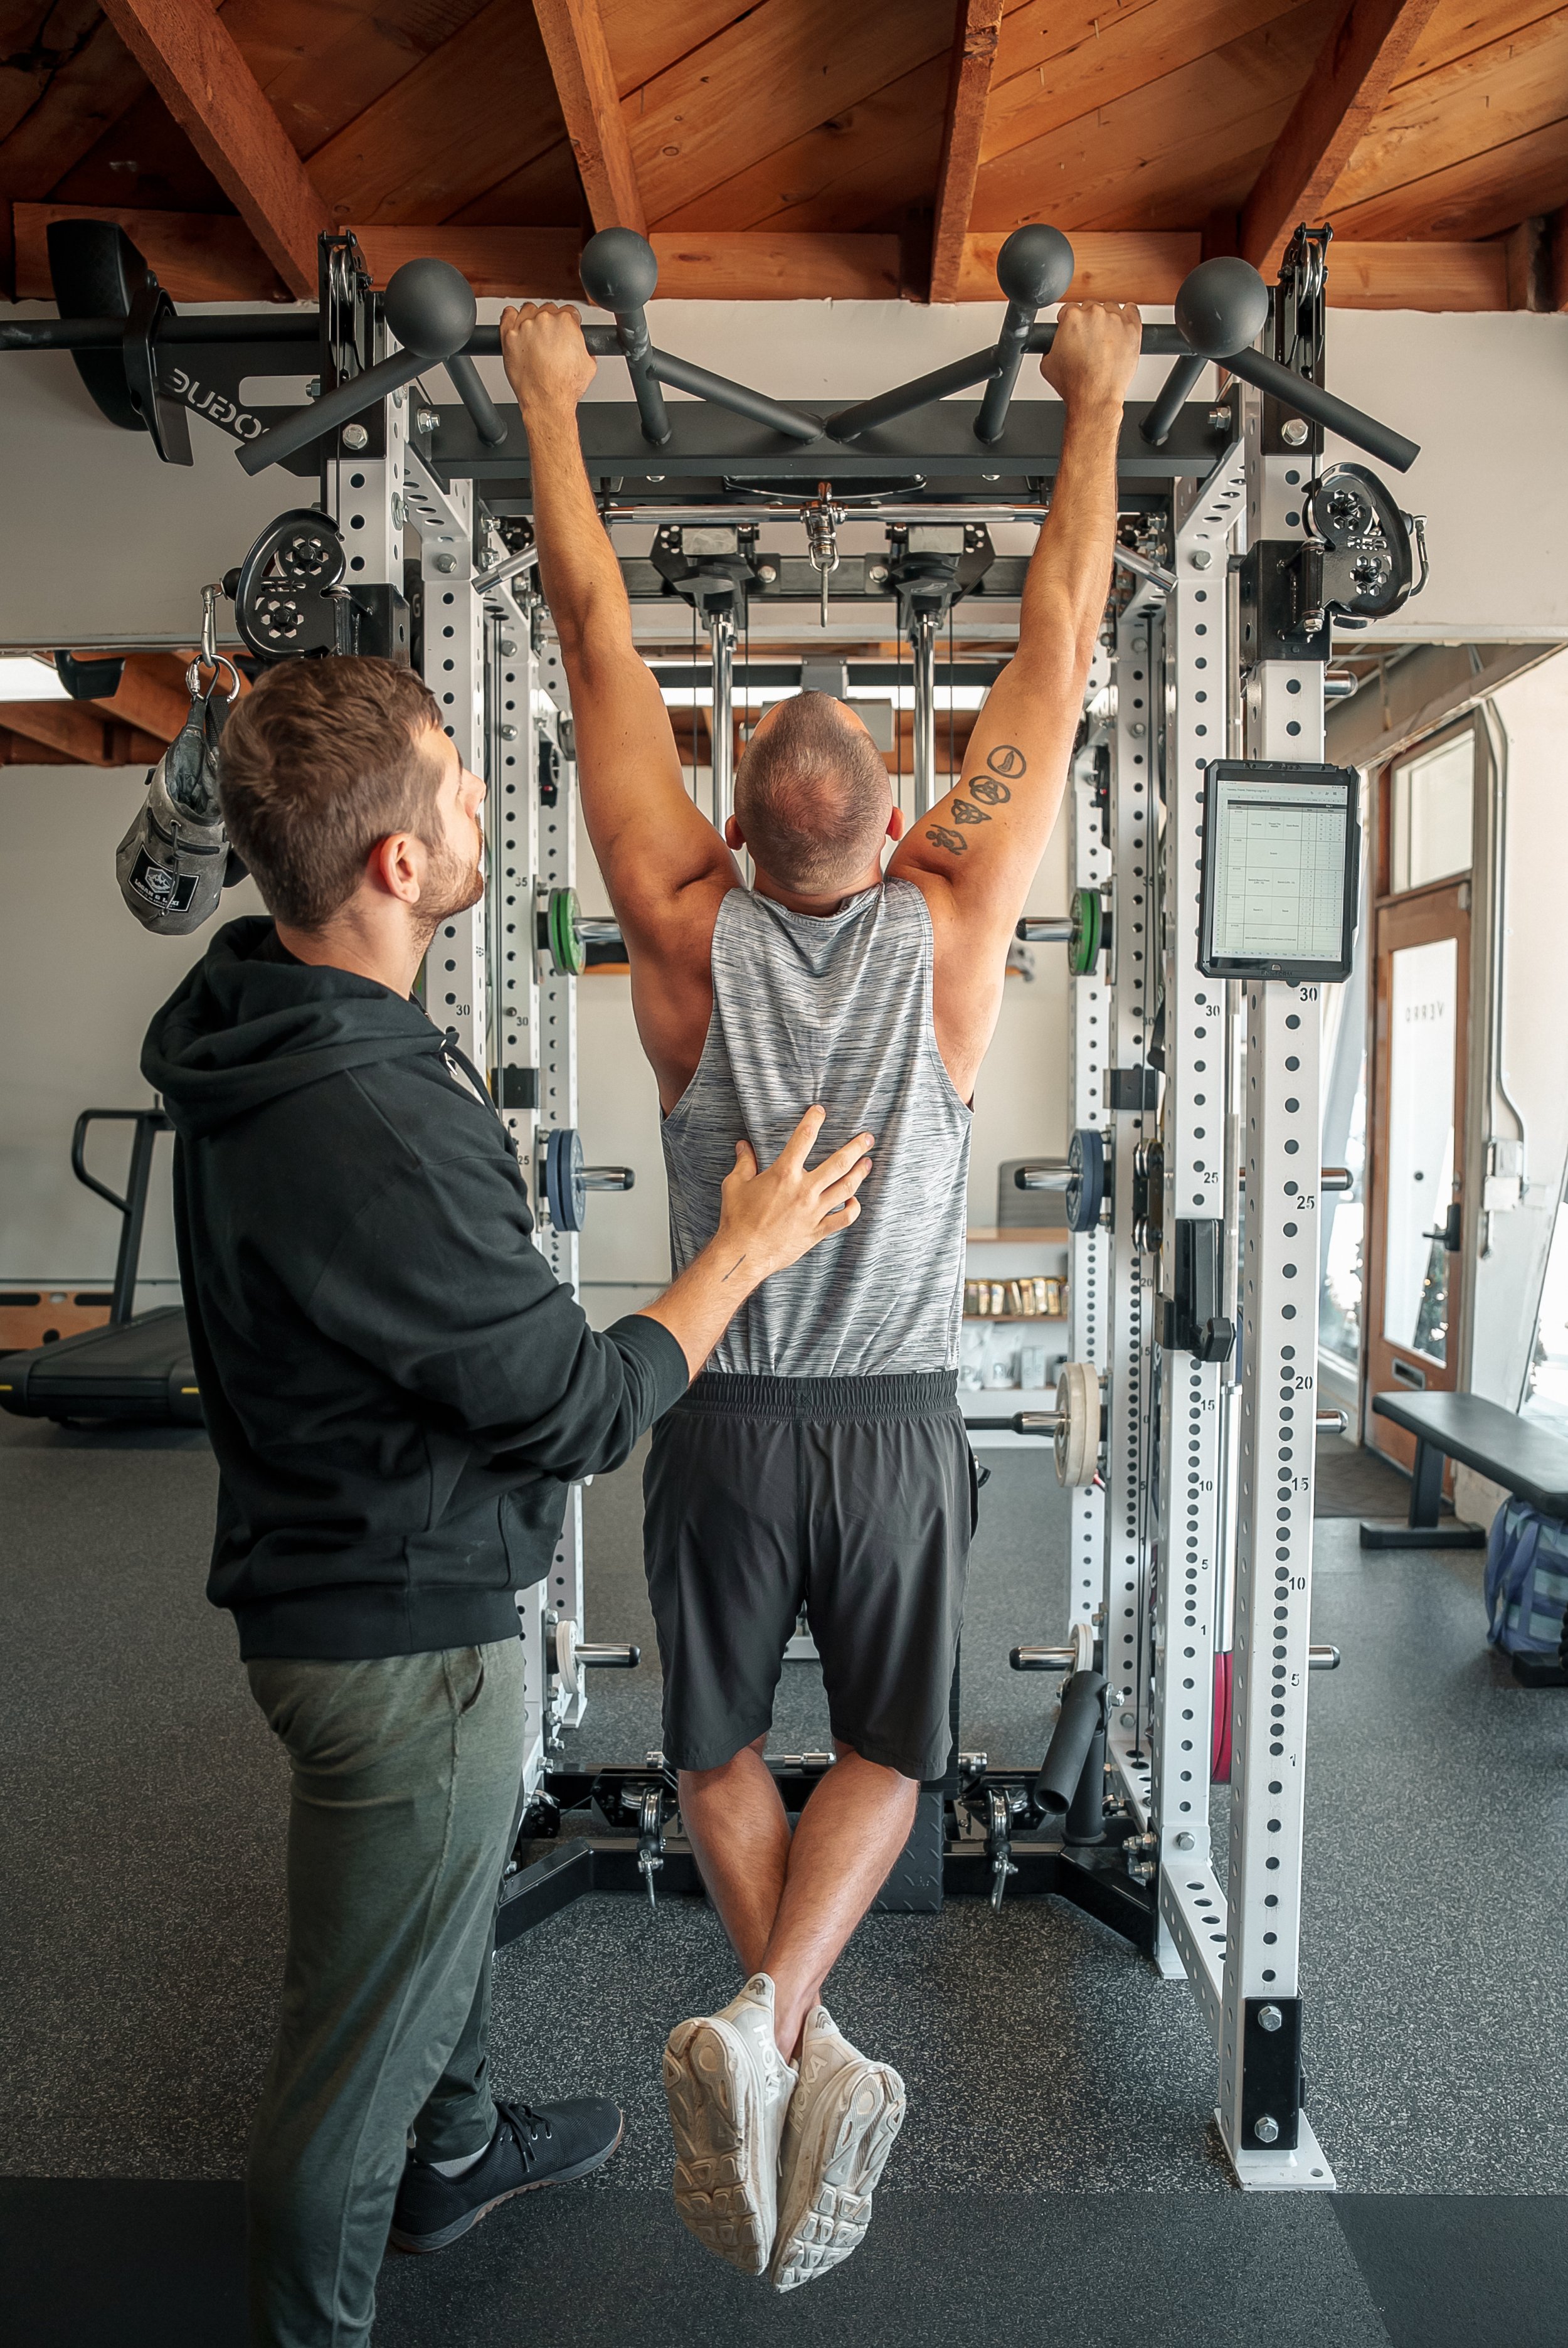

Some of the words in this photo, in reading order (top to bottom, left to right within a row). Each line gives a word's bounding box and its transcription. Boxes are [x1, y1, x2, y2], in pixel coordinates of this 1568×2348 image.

[516, 877, 527, 887] 35
[135, 878, 154, 897] LOGAN
[162, 898, 179, 906] LXI
[1300, 987, 1317, 1002] 30
[456, 1004, 470, 1016] 30
[1205, 1005, 1220, 1016] 30
[517, 1017, 529, 1026] 30
[518, 1155, 529, 1165] 25
[1204, 1172, 1218, 1184] 25
[1297, 1196, 1315, 1209] 25
[1141, 1278, 1153, 1287] 20
[1295, 1376, 1313, 1390] 20
[1200, 1400, 1215, 1411] 15
[1199, 1480, 1212, 1492] 10
[1292, 1477, 1309, 1491] 15
[1201, 1559, 1209, 1570] 5
[1289, 1576, 1305, 1591] 10
[1201, 1625, 1206, 1635] 1
[1291, 1673, 1300, 1687] 5
[1290, 1754, 1296, 1767] 1
[753, 2023, 780, 2106] HOKA
[789, 2054, 828, 2133] HOKA
